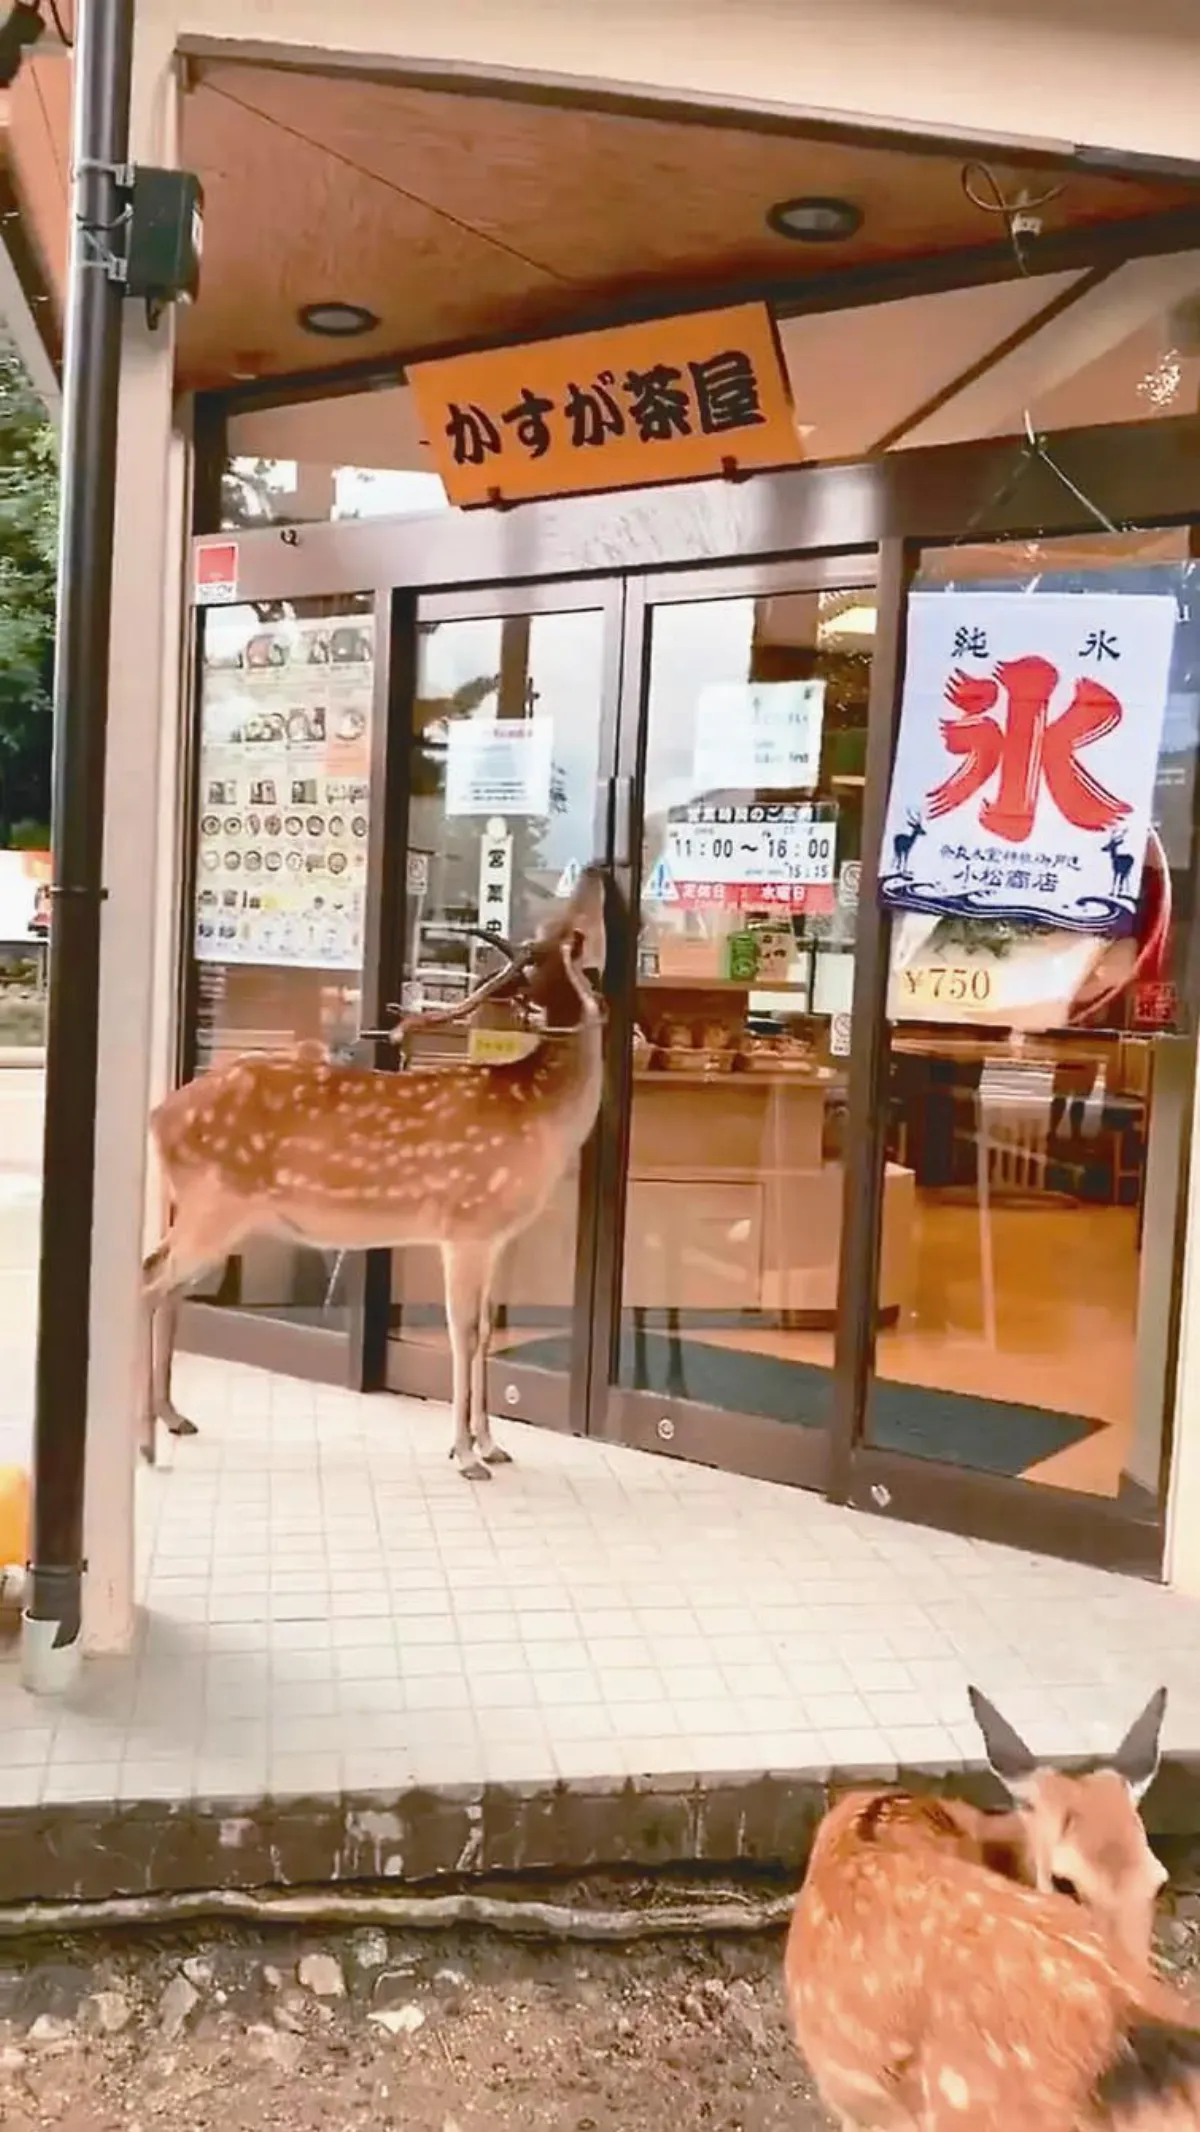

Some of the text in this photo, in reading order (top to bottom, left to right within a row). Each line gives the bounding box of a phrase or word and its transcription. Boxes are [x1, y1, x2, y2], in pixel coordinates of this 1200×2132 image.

[445, 350, 767, 465] かすが茶屋
[925, 655, 1134, 842] 氷
[953, 864, 1060, 893] 小松商店
[903, 967, 991, 1000] ¥750
